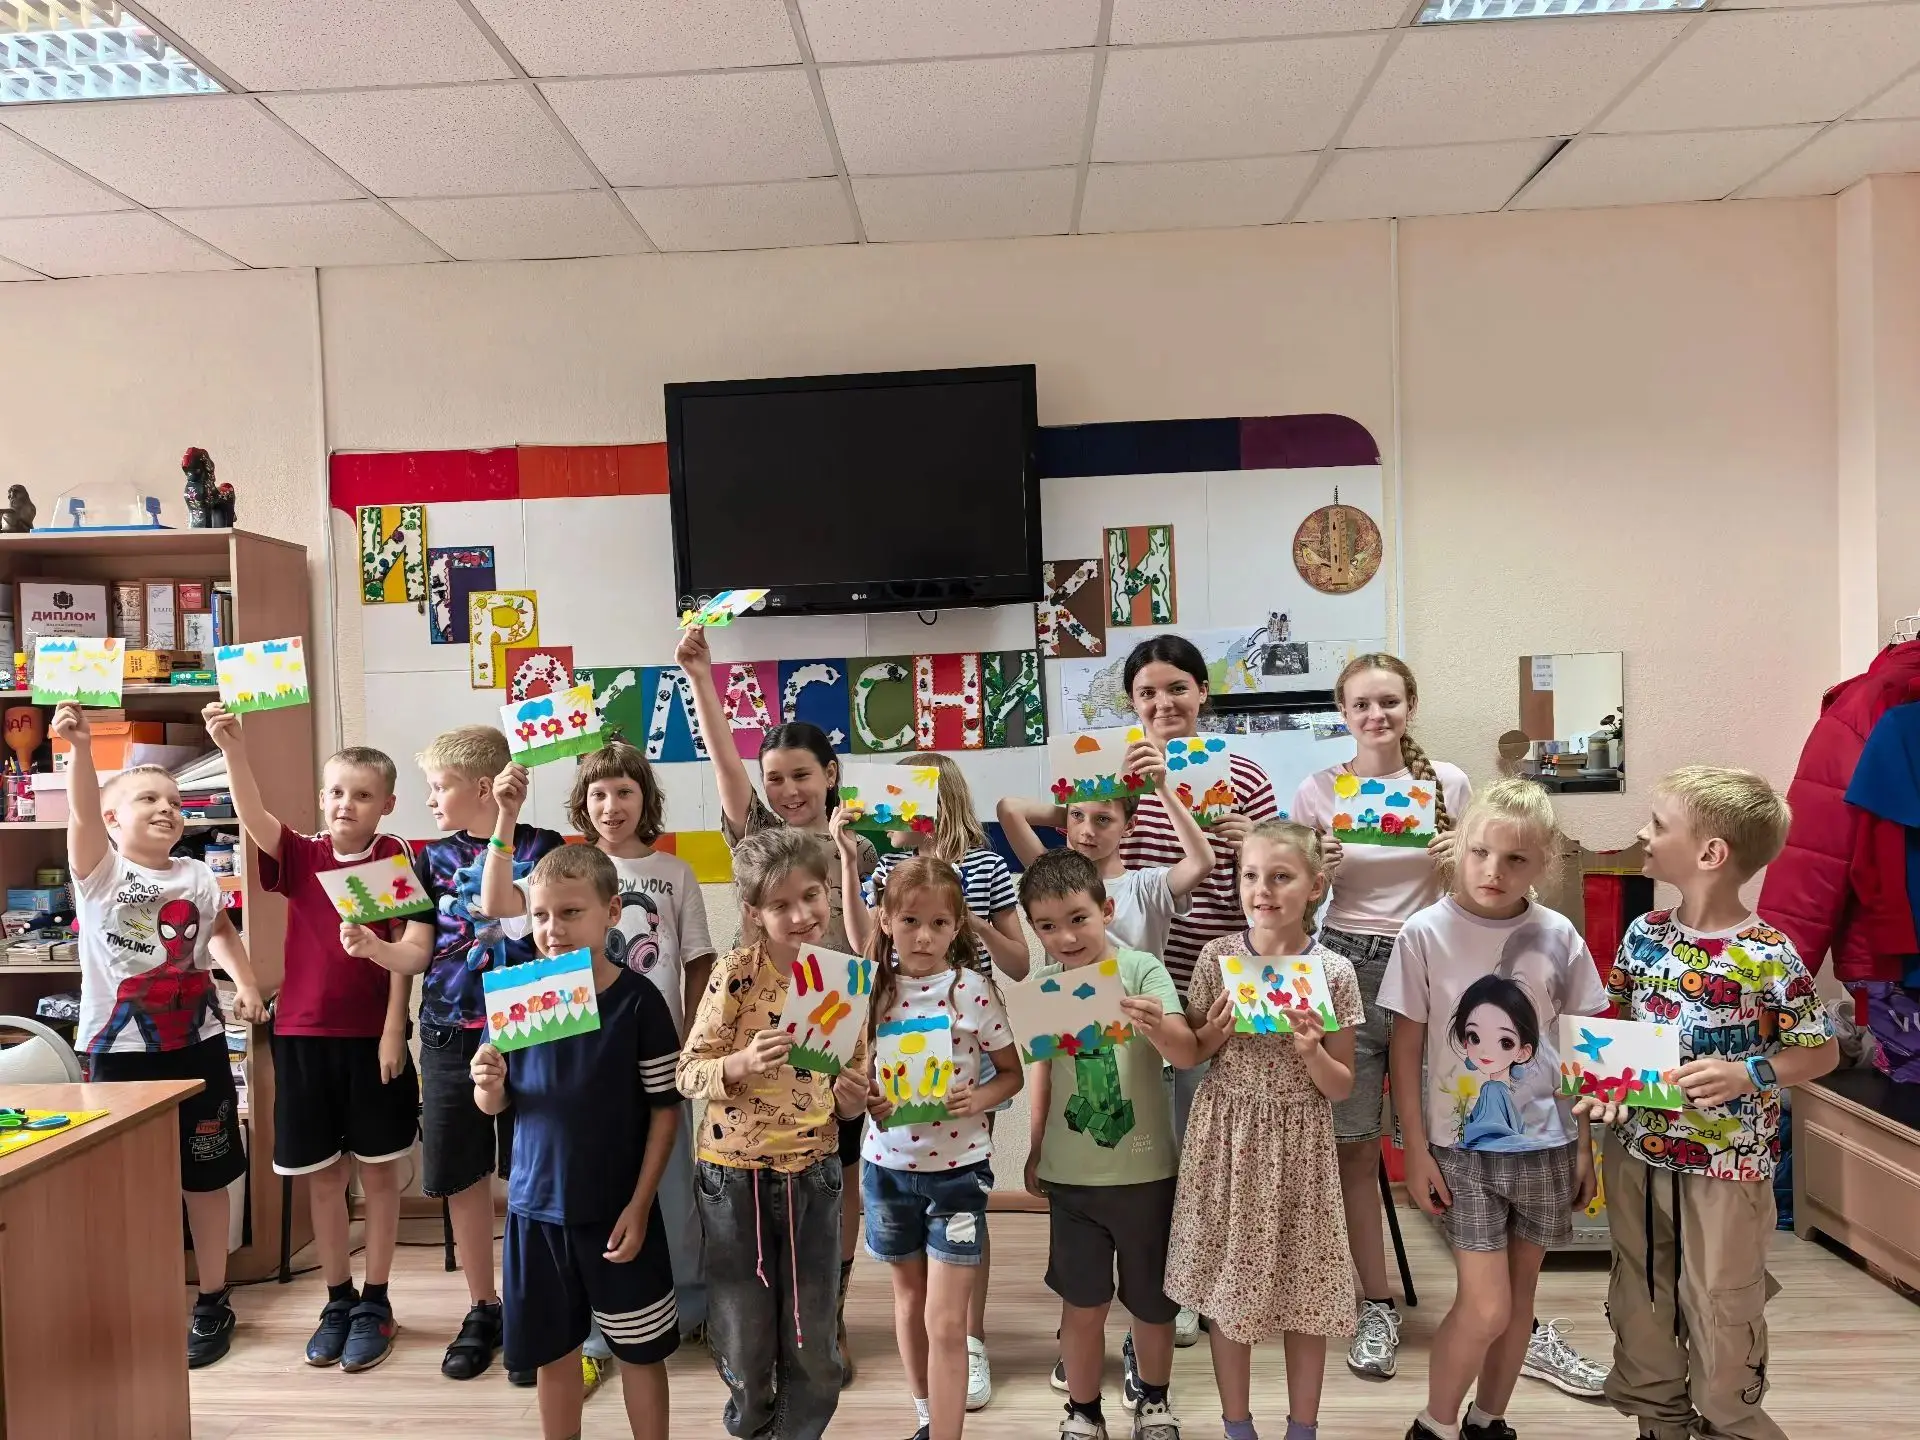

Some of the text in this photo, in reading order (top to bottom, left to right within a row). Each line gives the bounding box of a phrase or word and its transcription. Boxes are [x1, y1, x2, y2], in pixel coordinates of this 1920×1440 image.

[31, 611, 96, 622] ДИПЛОМ
[125, 871, 138, 883] MY
[640, 877, 674, 896] YOUR
[106, 931, 156, 956] TINGLING!
[1710, 960, 1761, 982] PERSON
[1669, 1123, 1721, 1141] PERSON
